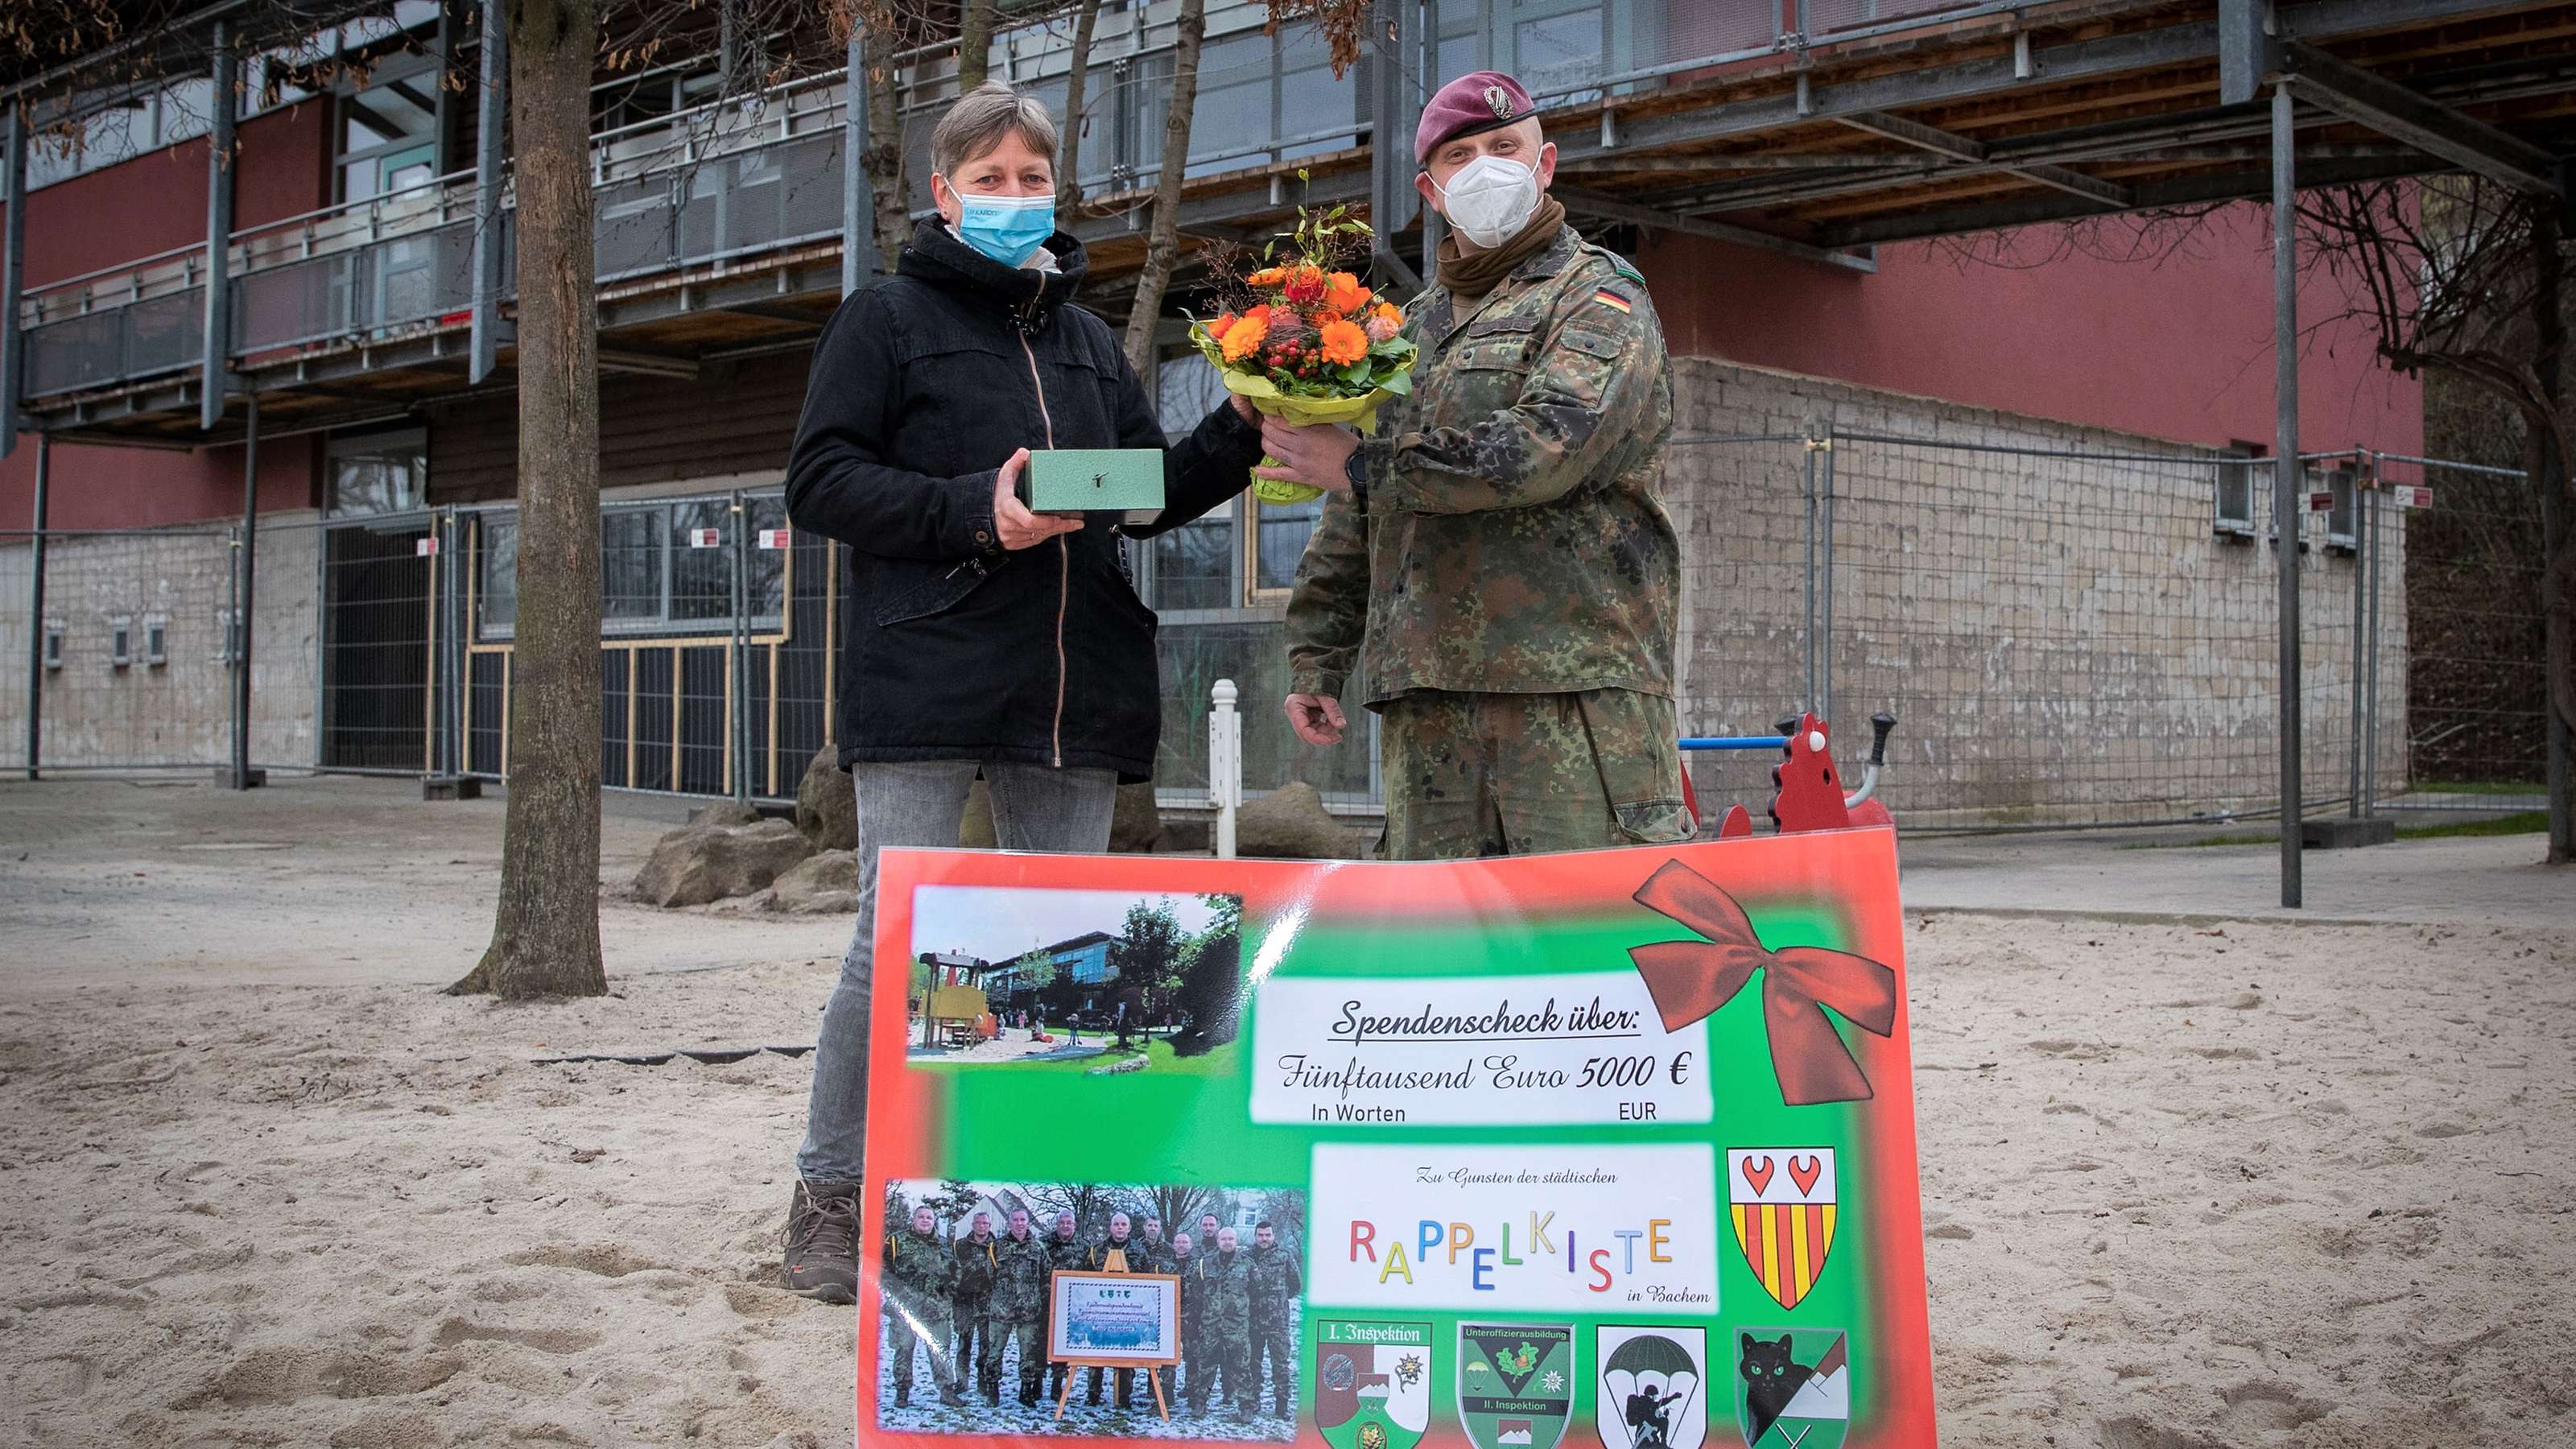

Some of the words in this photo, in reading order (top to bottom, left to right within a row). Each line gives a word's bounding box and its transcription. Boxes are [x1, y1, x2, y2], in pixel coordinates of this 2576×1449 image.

[1331, 999, 1563, 1046] Spendenscheck
[1568, 996, 1640, 1032] über:
[1278, 1053, 1476, 1101] Fünftausend
[1483, 1055, 1570, 1089] Euro
[1575, 1055, 1655, 1088] 5000
[1669, 1051, 1692, 1085] €
[1311, 1103, 1328, 1121] In
[1335, 1104, 1406, 1123] Worten
[1619, 1102, 1657, 1121] EUR
[1416, 1166, 1444, 1184] Zu
[1448, 1167, 1514, 1188] Gunsten
[1517, 1168, 1539, 1185] der
[1542, 1168, 1618, 1185] städtischen
[1349, 1210, 1673, 1293] RAPPELKISTE
[1627, 1289, 1643, 1302] in
[1646, 1286, 1712, 1304] Bachem
[1345, 1323, 1420, 1343] Inspektion
[1465, 1328, 1567, 1340] Unteroffizierausbildung
[1484, 1400, 1493, 1410] II.
[1496, 1401, 1546, 1411] Inspektion
